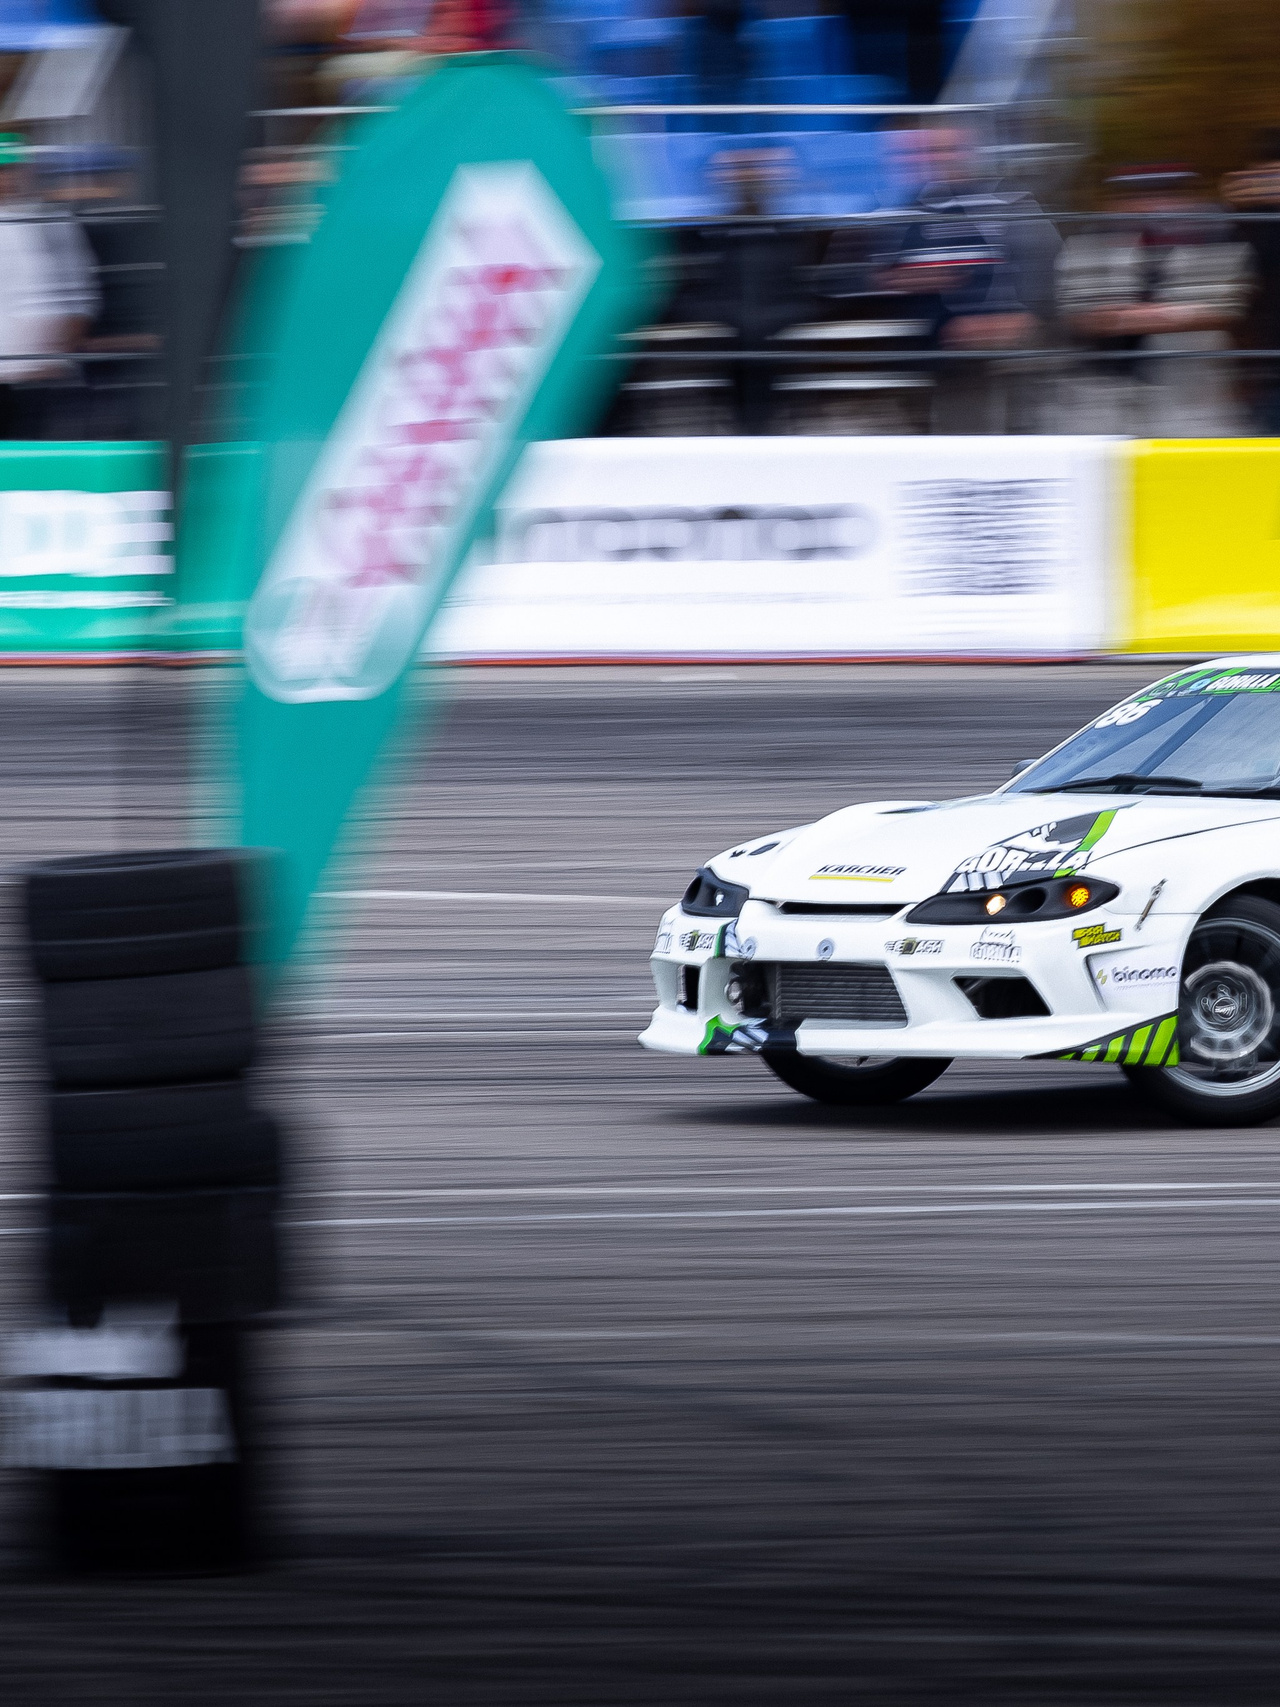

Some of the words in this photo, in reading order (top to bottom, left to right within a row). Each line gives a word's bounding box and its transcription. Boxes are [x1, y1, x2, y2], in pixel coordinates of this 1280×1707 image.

[1206, 674, 1280, 691] GORILLA
[1094, 699, 1164, 729] 86
[1112, 966, 1177, 983] binomo
